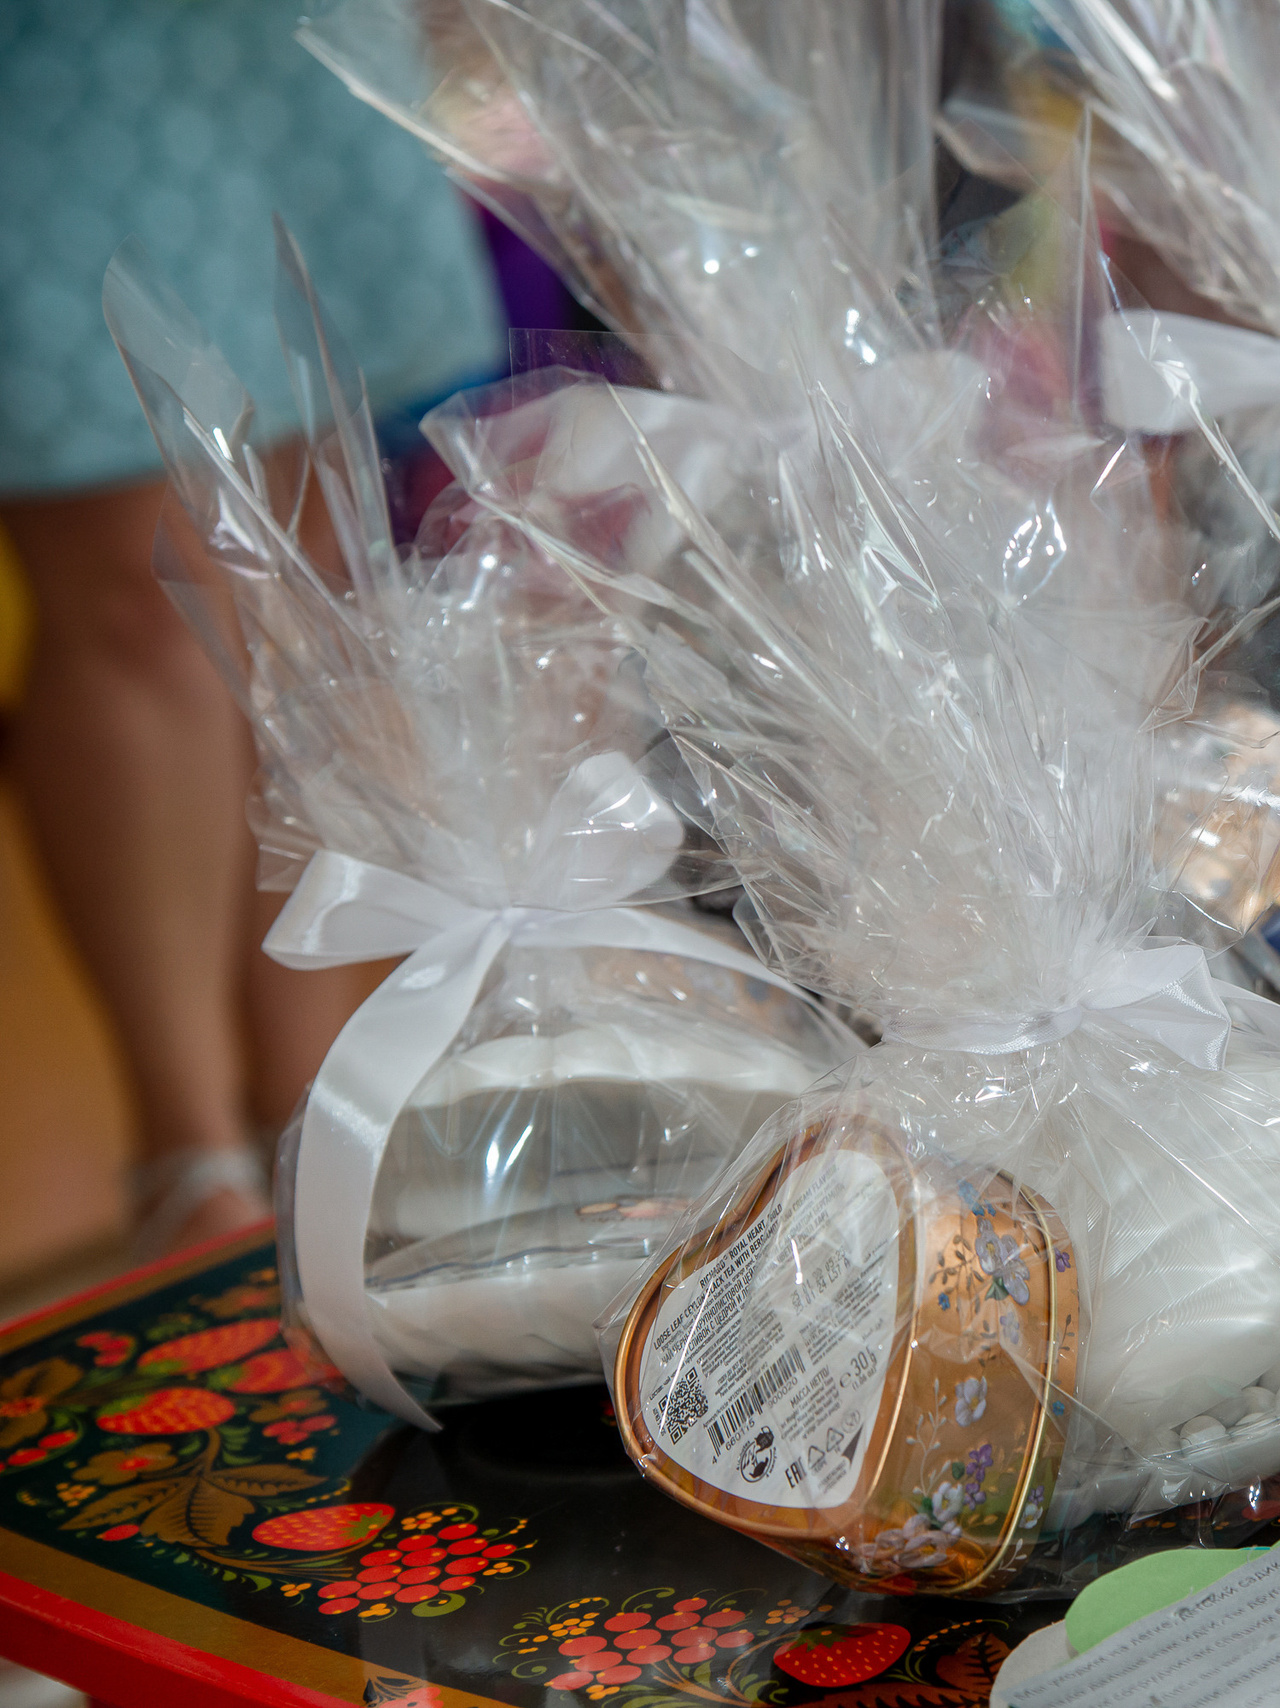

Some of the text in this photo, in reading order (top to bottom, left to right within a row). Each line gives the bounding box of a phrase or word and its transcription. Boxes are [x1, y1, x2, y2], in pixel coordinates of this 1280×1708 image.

[728, 1239, 746, 1259] ROYAL
[653, 1327, 670, 1350] LOOSE
[669, 1313, 684, 1332] LEAF
[683, 1292, 706, 1317] CEYLON
[723, 1265, 734, 1278] TEA
[734, 1249, 750, 1268] WITH
[849, 1350, 868, 1377] 30
